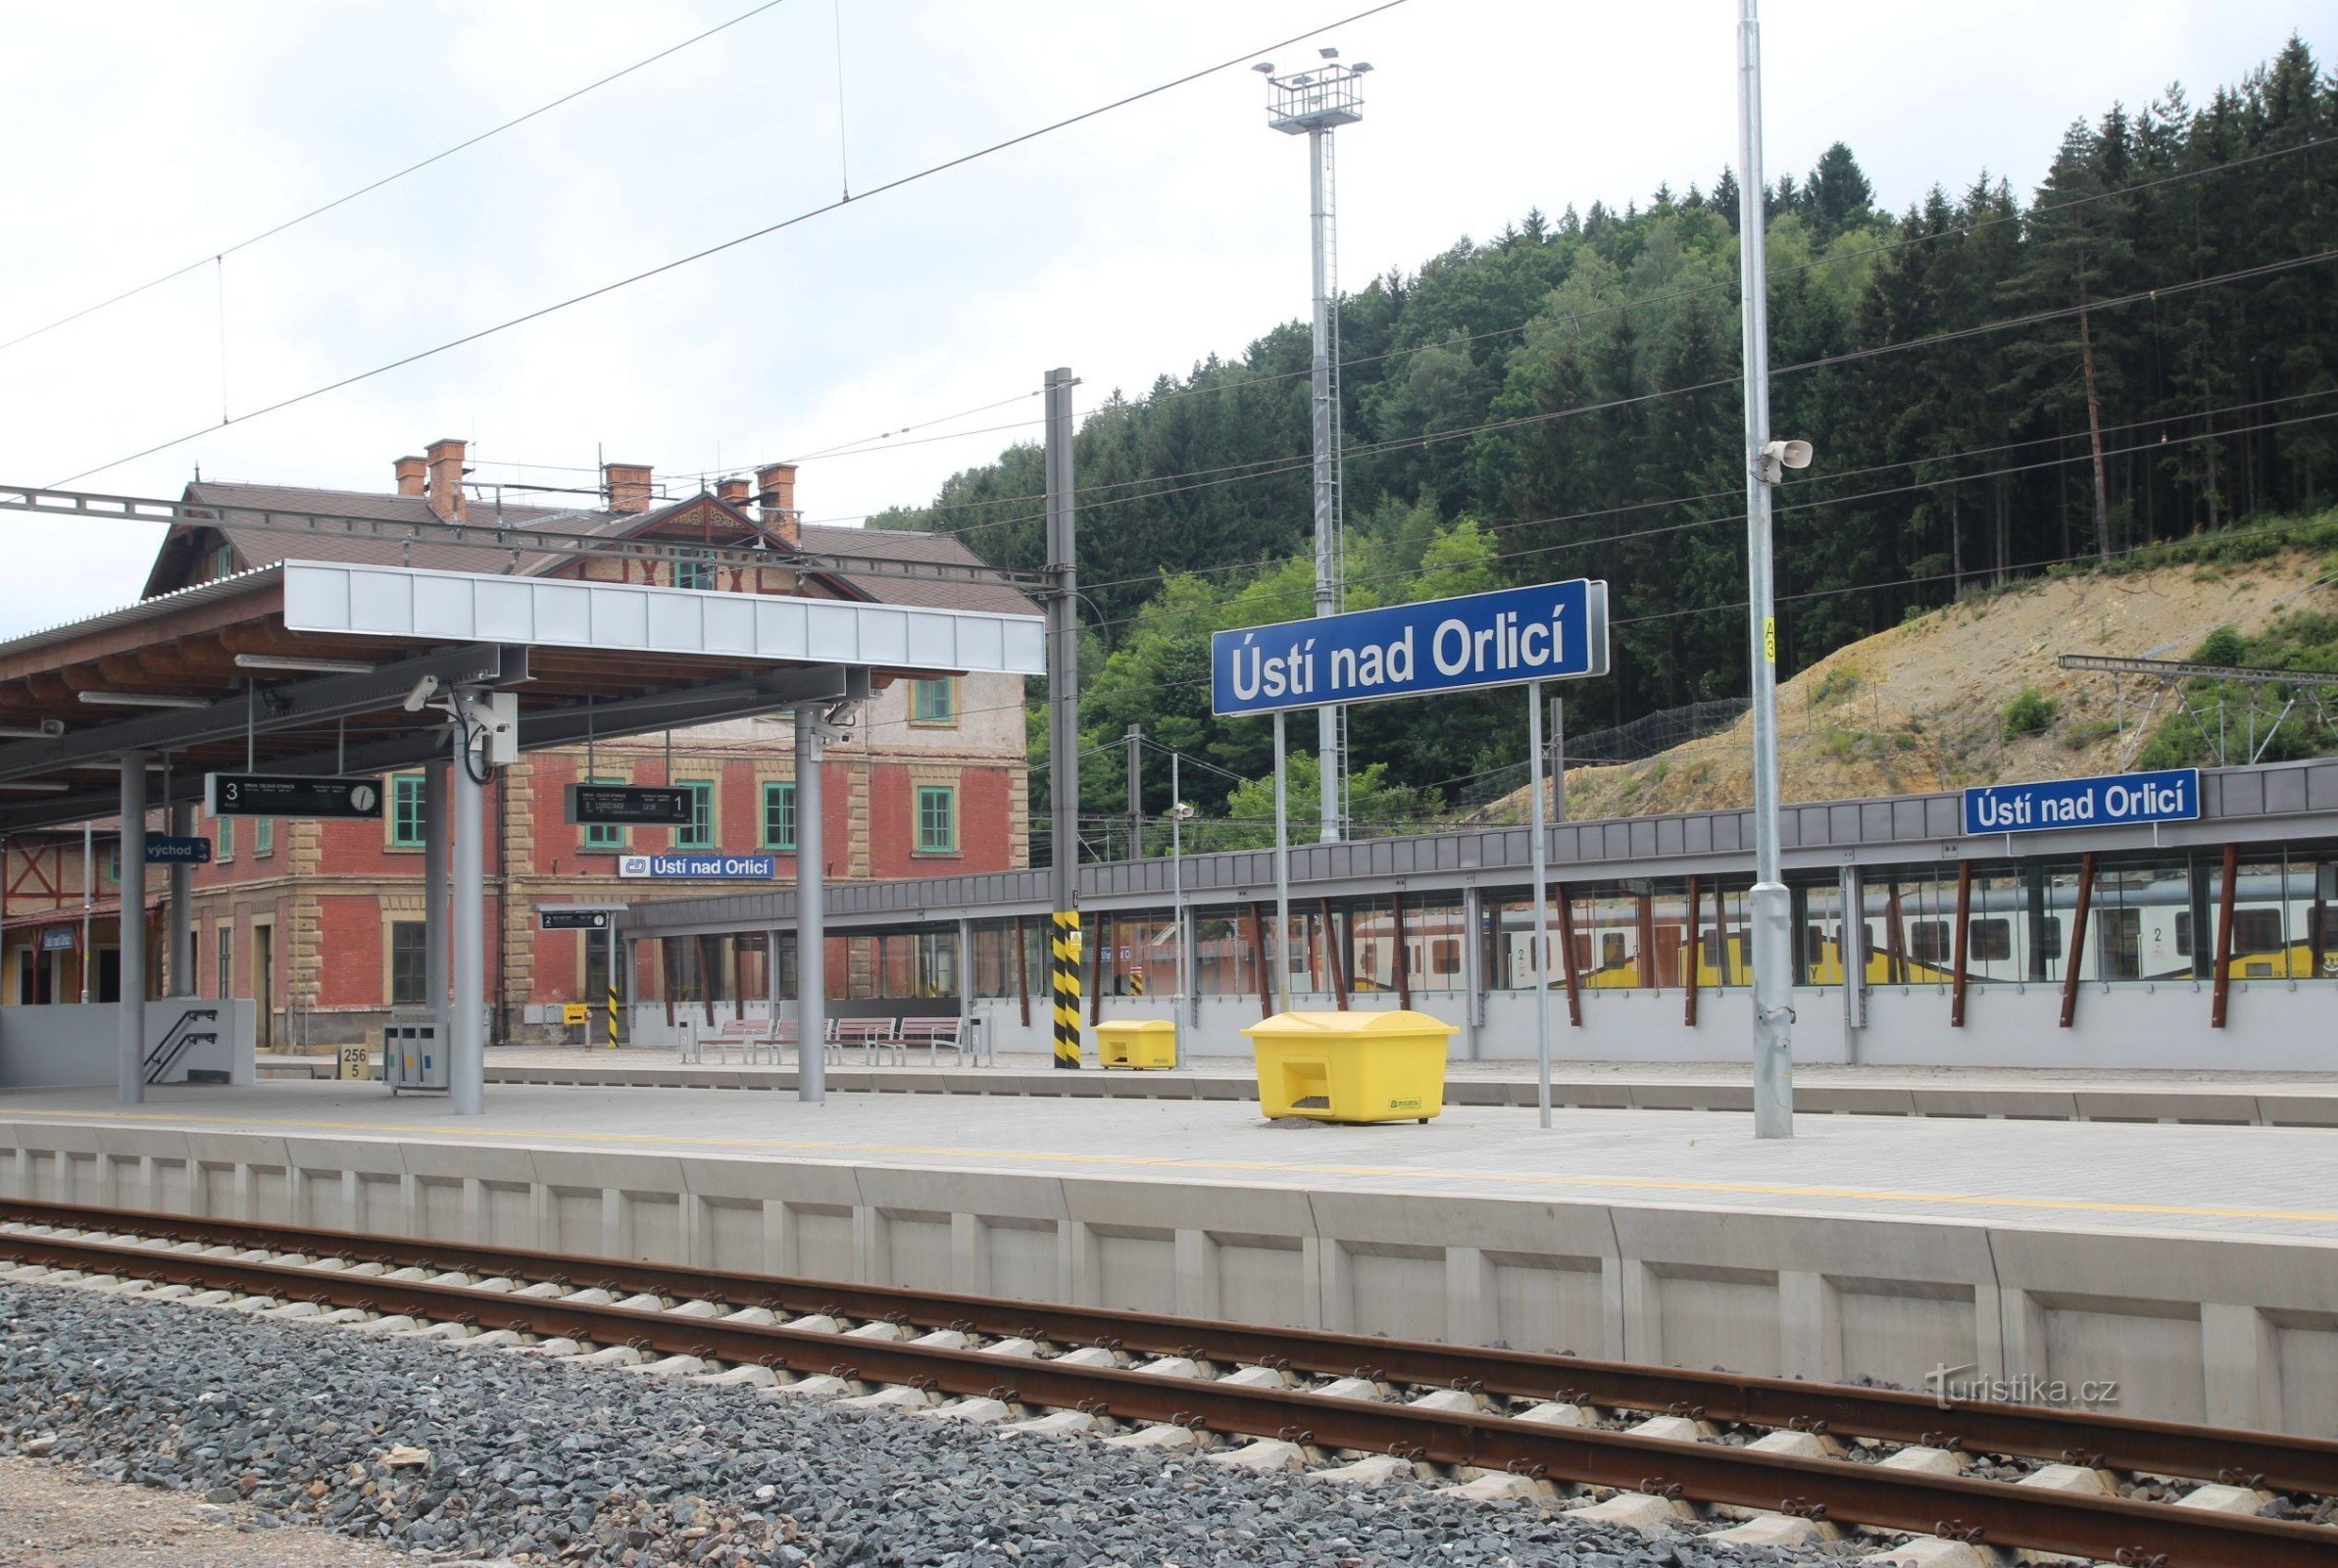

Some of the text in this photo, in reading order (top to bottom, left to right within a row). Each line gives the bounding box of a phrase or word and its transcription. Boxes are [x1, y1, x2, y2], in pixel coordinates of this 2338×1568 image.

[1232, 604, 1566, 700] Ústí nad Orlicí
[226, 783, 238, 800] 3
[674, 796, 681, 811] 1
[1977, 779, 2184, 827] Ústí nad Orlicí
[147, 845, 192, 858] východ
[655, 856, 687, 874] Ústí
[691, 859, 721, 874] nad
[725, 858, 769, 874] Orlicí
[2154, 928, 2162, 942] 2
[1519, 949, 1524, 960] 2
[344, 1049, 367, 1062] 256
[352, 1064, 359, 1077] 5
